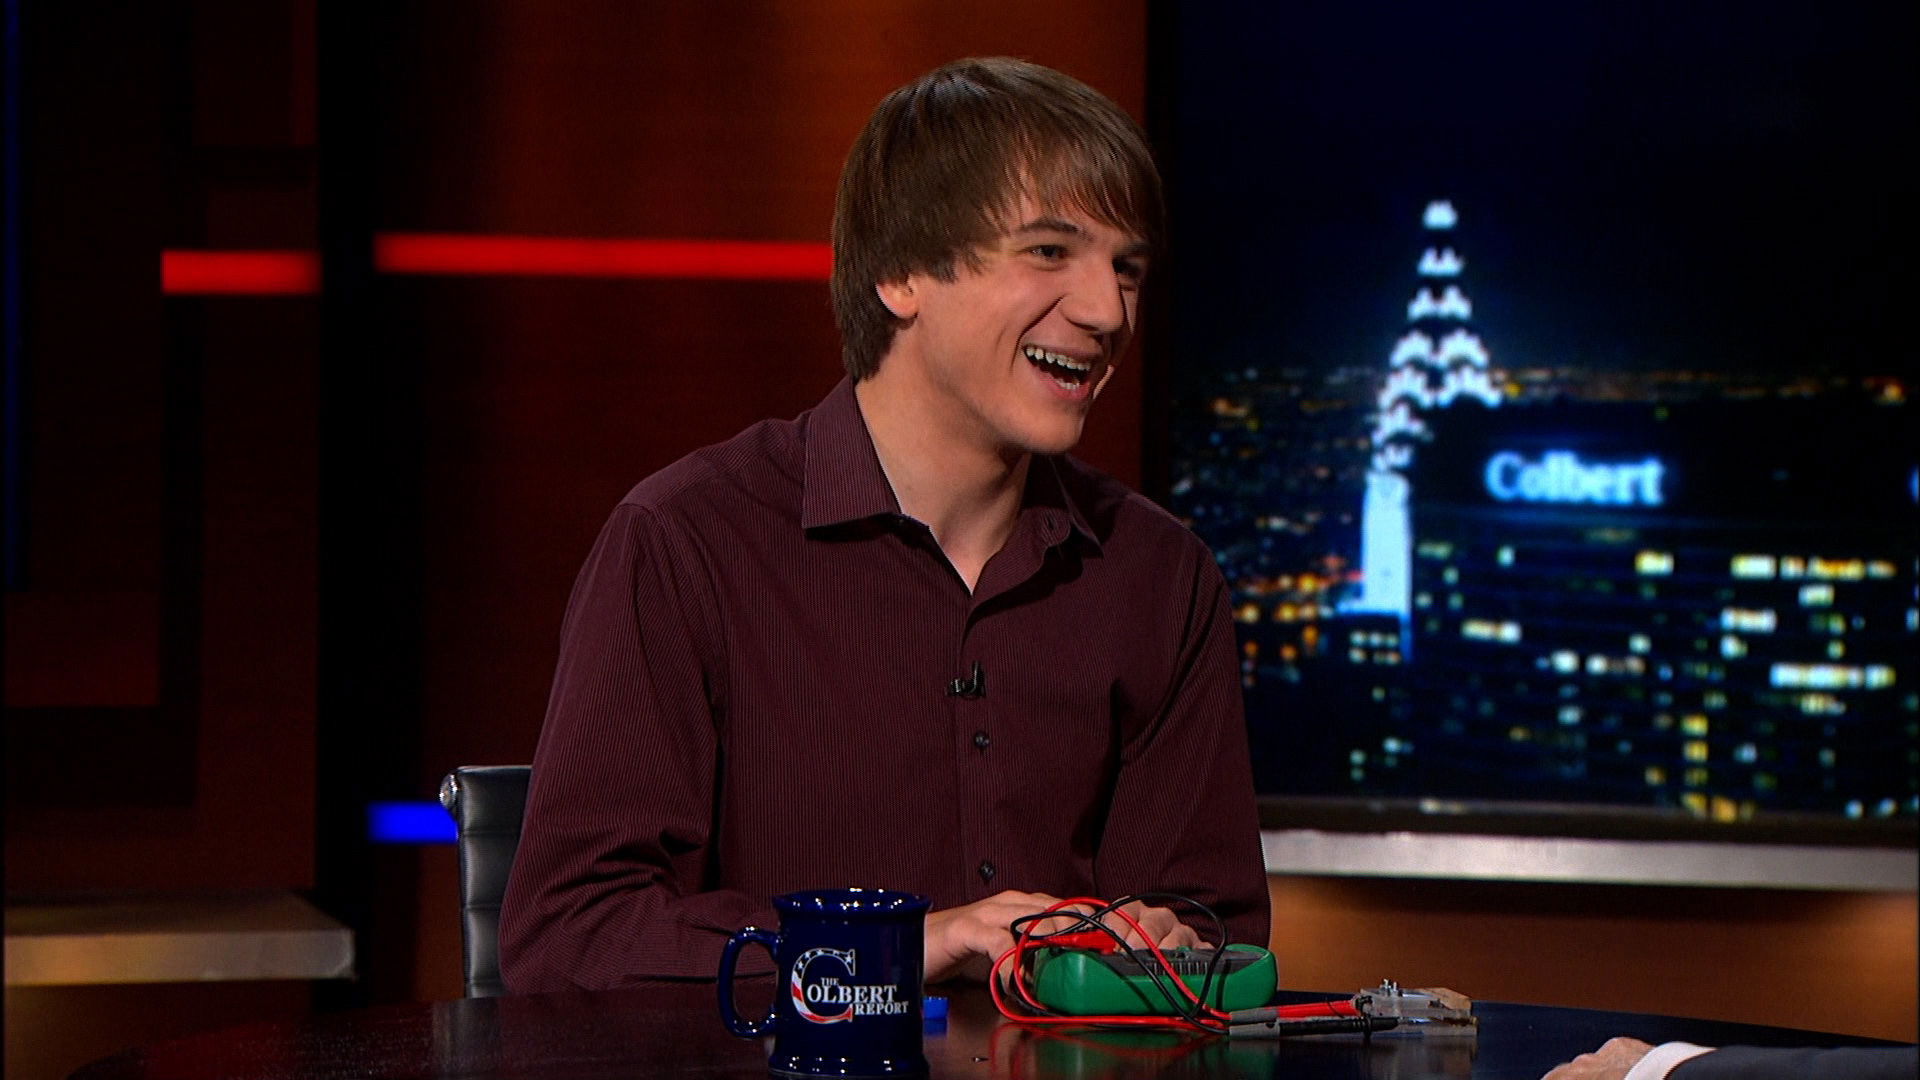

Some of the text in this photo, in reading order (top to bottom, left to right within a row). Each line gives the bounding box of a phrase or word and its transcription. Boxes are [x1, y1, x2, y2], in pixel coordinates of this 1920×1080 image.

[1485, 451, 1664, 506] Colbert
[821, 977, 839, 987] THE
[854, 1001, 909, 1016] REPORT
